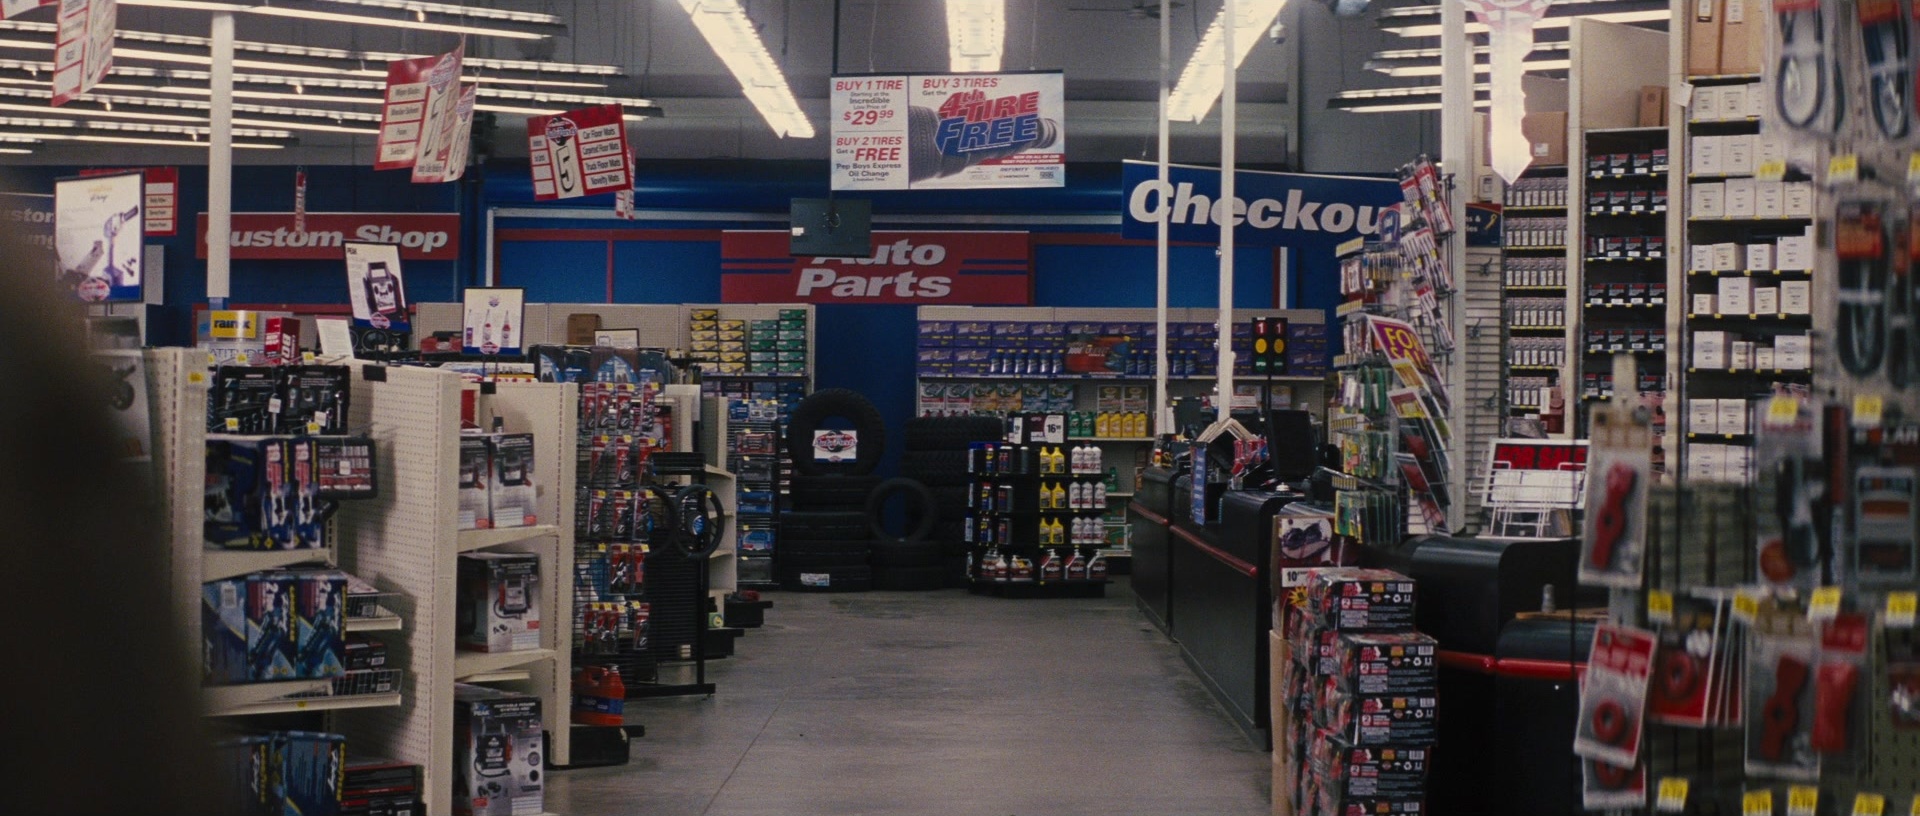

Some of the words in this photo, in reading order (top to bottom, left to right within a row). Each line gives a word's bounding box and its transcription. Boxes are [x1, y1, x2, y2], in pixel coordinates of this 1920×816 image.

[836, 81, 862, 91] BUY
[867, 81, 873, 90] 1
[875, 80, 903, 90] TIRE
[923, 79, 950, 89] BUY
[952, 78, 961, 88] 3
[964, 78, 998, 87] TIRES
[938, 89, 986, 119] 4th
[965, 91, 1040, 123] TIRE
[583, 131, 591, 139] Car
[591, 130, 602, 138] Floor
[603, 128, 616, 136] Mats
[935, 114, 1038, 155] FREE
[599, 144, 609, 152] Floor
[609, 143, 619, 151] Mats
[836, 137, 860, 146] BUY
[861, 137, 869, 145] 2
[871, 137, 903, 146] TIRES
[855, 148, 901, 161] FREE
[556, 145, 575, 192] 5
[585, 162, 597, 170] Truck
[597, 160, 609, 169] Floor
[609, 159, 621, 167] Mats
[590, 176, 608, 185] Novelty
[608, 175, 620, 183] Mats
[1129, 178, 1386, 237] Checkou
[205, 226, 343, 249] ustom
[356, 224, 448, 253] Shop
[811, 238, 946, 266] uto
[796, 268, 952, 298] Parts
[1258, 322, 1265, 334] 1
[1276, 322, 1282, 334] 1
[1496, 446, 1537, 470] FOR
[1538, 446, 1588, 471] SALE
[1287, 571, 1298, 581] 10
